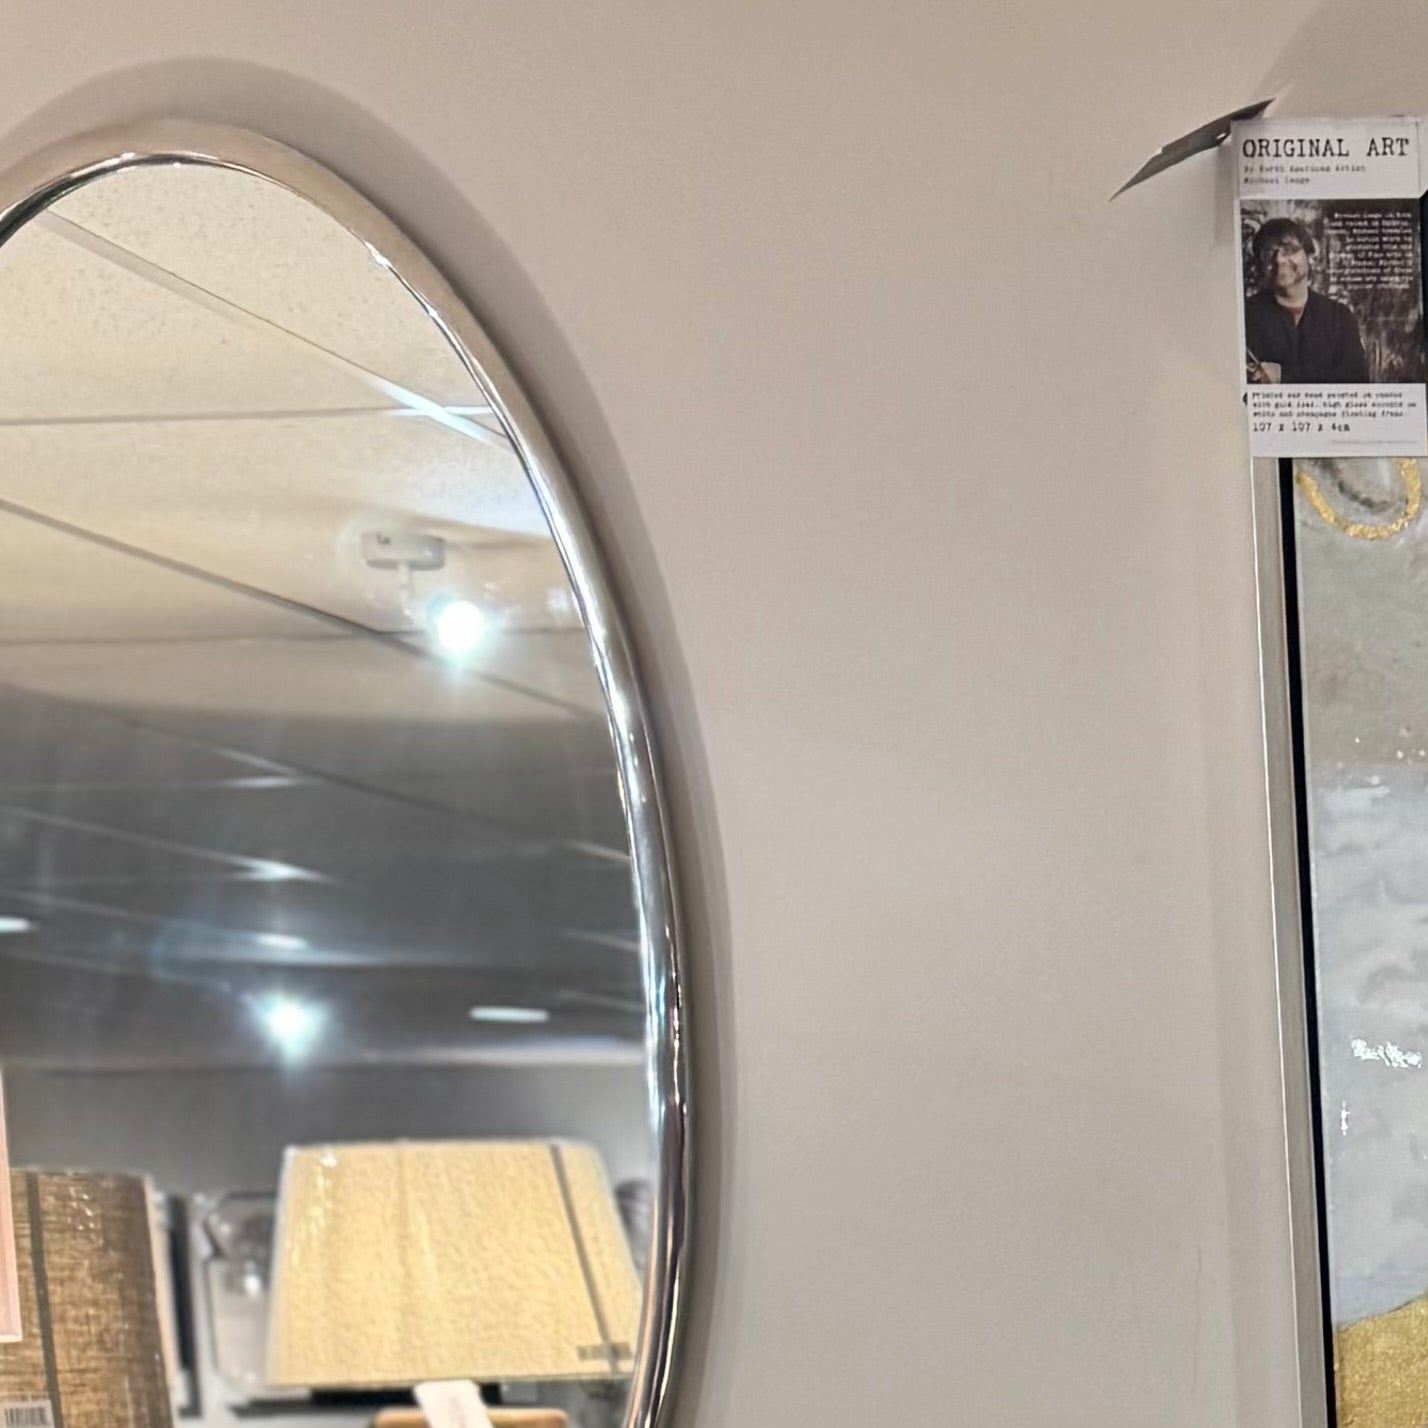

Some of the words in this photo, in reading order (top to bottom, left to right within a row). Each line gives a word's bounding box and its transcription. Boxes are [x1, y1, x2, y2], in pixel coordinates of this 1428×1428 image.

[1242, 138, 1350, 159] ORIGINAL
[1366, 137, 1410, 157] ART
[1253, 422, 1272, 433] 107
[1292, 421, 1311, 433] 107
